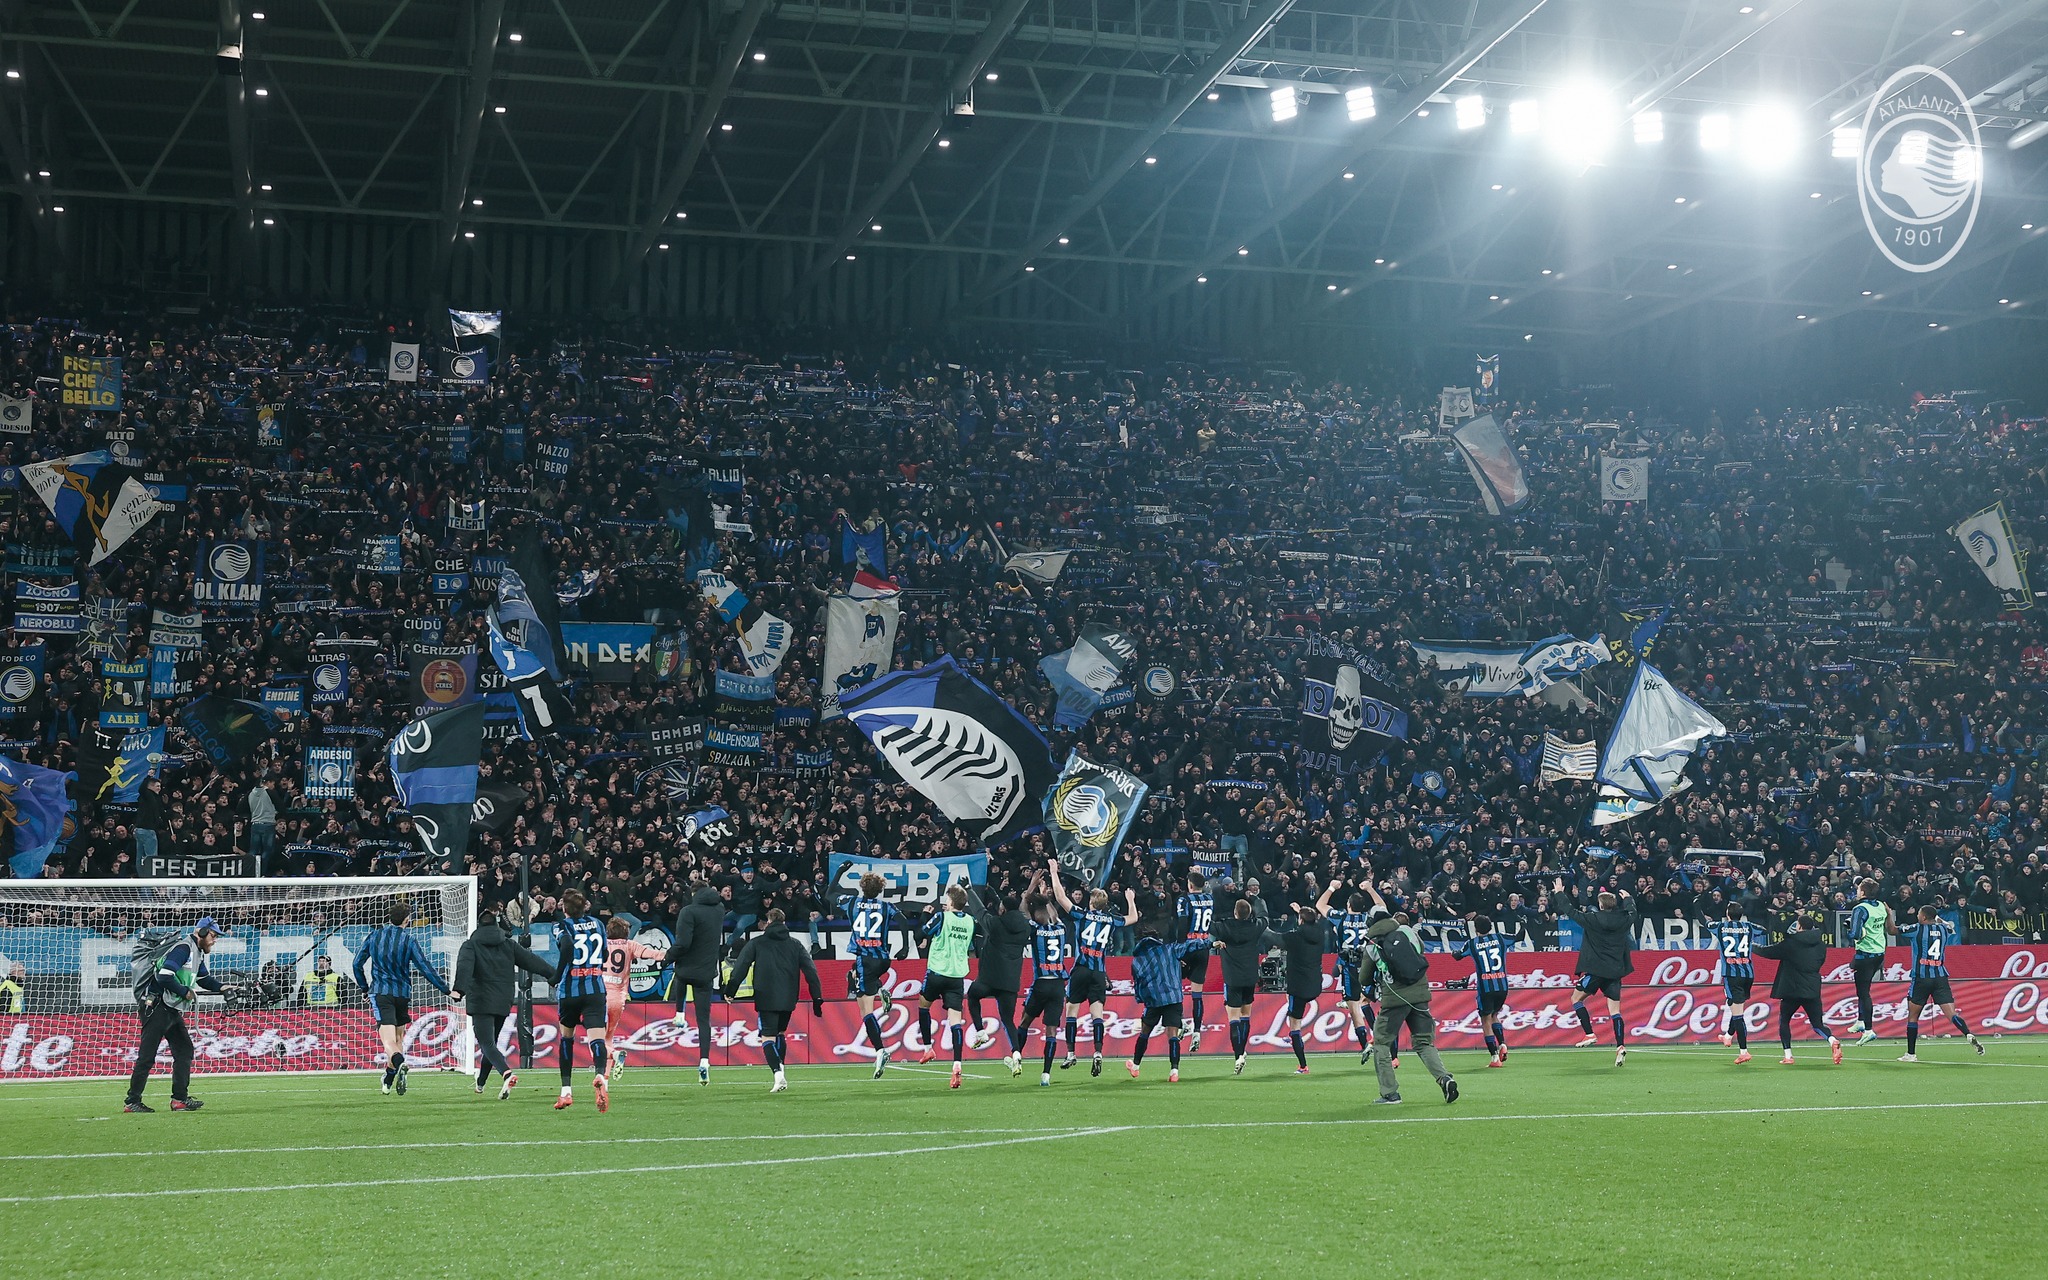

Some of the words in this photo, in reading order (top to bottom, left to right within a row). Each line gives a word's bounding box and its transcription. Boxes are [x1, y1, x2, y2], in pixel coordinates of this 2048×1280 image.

[442, 347, 485, 356] TOTALMENTE
[64, 355, 103, 372] FIGA
[64, 373, 97, 388] CHE
[63, 389, 116, 406] BELLO
[106, 431, 135, 442] ALTO
[537, 443, 569, 458] PIAZZO
[535, 459, 568, 474] LBERO
[144, 471, 164, 482] SARÀ
[448, 517, 484, 530] TELGAT
[20, 557, 59, 566] LOTTA
[434, 560, 463, 571] CHE
[25, 585, 70, 597] ZOGNO
[193, 578, 214, 600] ÖL
[217, 583, 263, 601] KLAN
[35, 603, 60, 613] 1907
[20, 617, 75, 630] NEROBLU
[162, 615, 195, 626] OSIO
[153, 632, 198, 645] SOPRA
[765, 622, 784, 650] MURI
[412, 641, 476, 656] CERIZZATI
[25, 654, 36, 662] CO
[308, 652, 346, 663] ULTRAS
[104, 662, 144, 674] STIRATI
[169, 667, 177, 680] A
[1488, 665, 1524, 682] Vivrò
[153, 680, 194, 696] BRACHE
[264, 691, 299, 702] ENDINE
[312, 690, 344, 702] SKALVÌ
[1103, 706, 1127, 718] 1907
[1304, 684, 1326, 715] 19
[1363, 701, 1396, 733] 07
[107, 713, 140, 725] ALBÌ
[779, 716, 811, 728] ALBINO
[652, 723, 702, 742] GAMBA
[708, 730, 760, 748] MALPENSADA
[94, 731, 112, 750] TI
[117, 733, 152, 752] AMO
[654, 741, 694, 757] TESA
[310, 750, 352, 761] ARDESIO
[796, 750, 832, 766] STUPE
[795, 766, 832, 778] FATTI
[305, 786, 355, 798] PRESENTE
[1211, 781, 1263, 790] BERGAMO
[984, 785, 1007, 817] ULTRAS
[700, 821, 733, 847] töt
[316, 845, 350, 857] ATALANT
[1192, 850, 1230, 862] DICIASSETTE
[152, 860, 196, 877] PER
[206, 860, 244, 877] CHI
[839, 863, 972, 904] SEBA
[852, 911, 884, 939] 42
[1194, 908, 1213, 932] 16
[1081, 922, 1111, 949] 44
[1341, 928, 1369, 949] 23
[572, 932, 604, 966] 32
[1046, 938, 1060, 961] 3
[1723, 934, 1750, 957] 24
[1927, 939, 1941, 961] 4
[1478, 948, 1501, 973] 13
[1631, 990, 1771, 1038] Lete
[832, 1002, 1001, 1057] Lete
